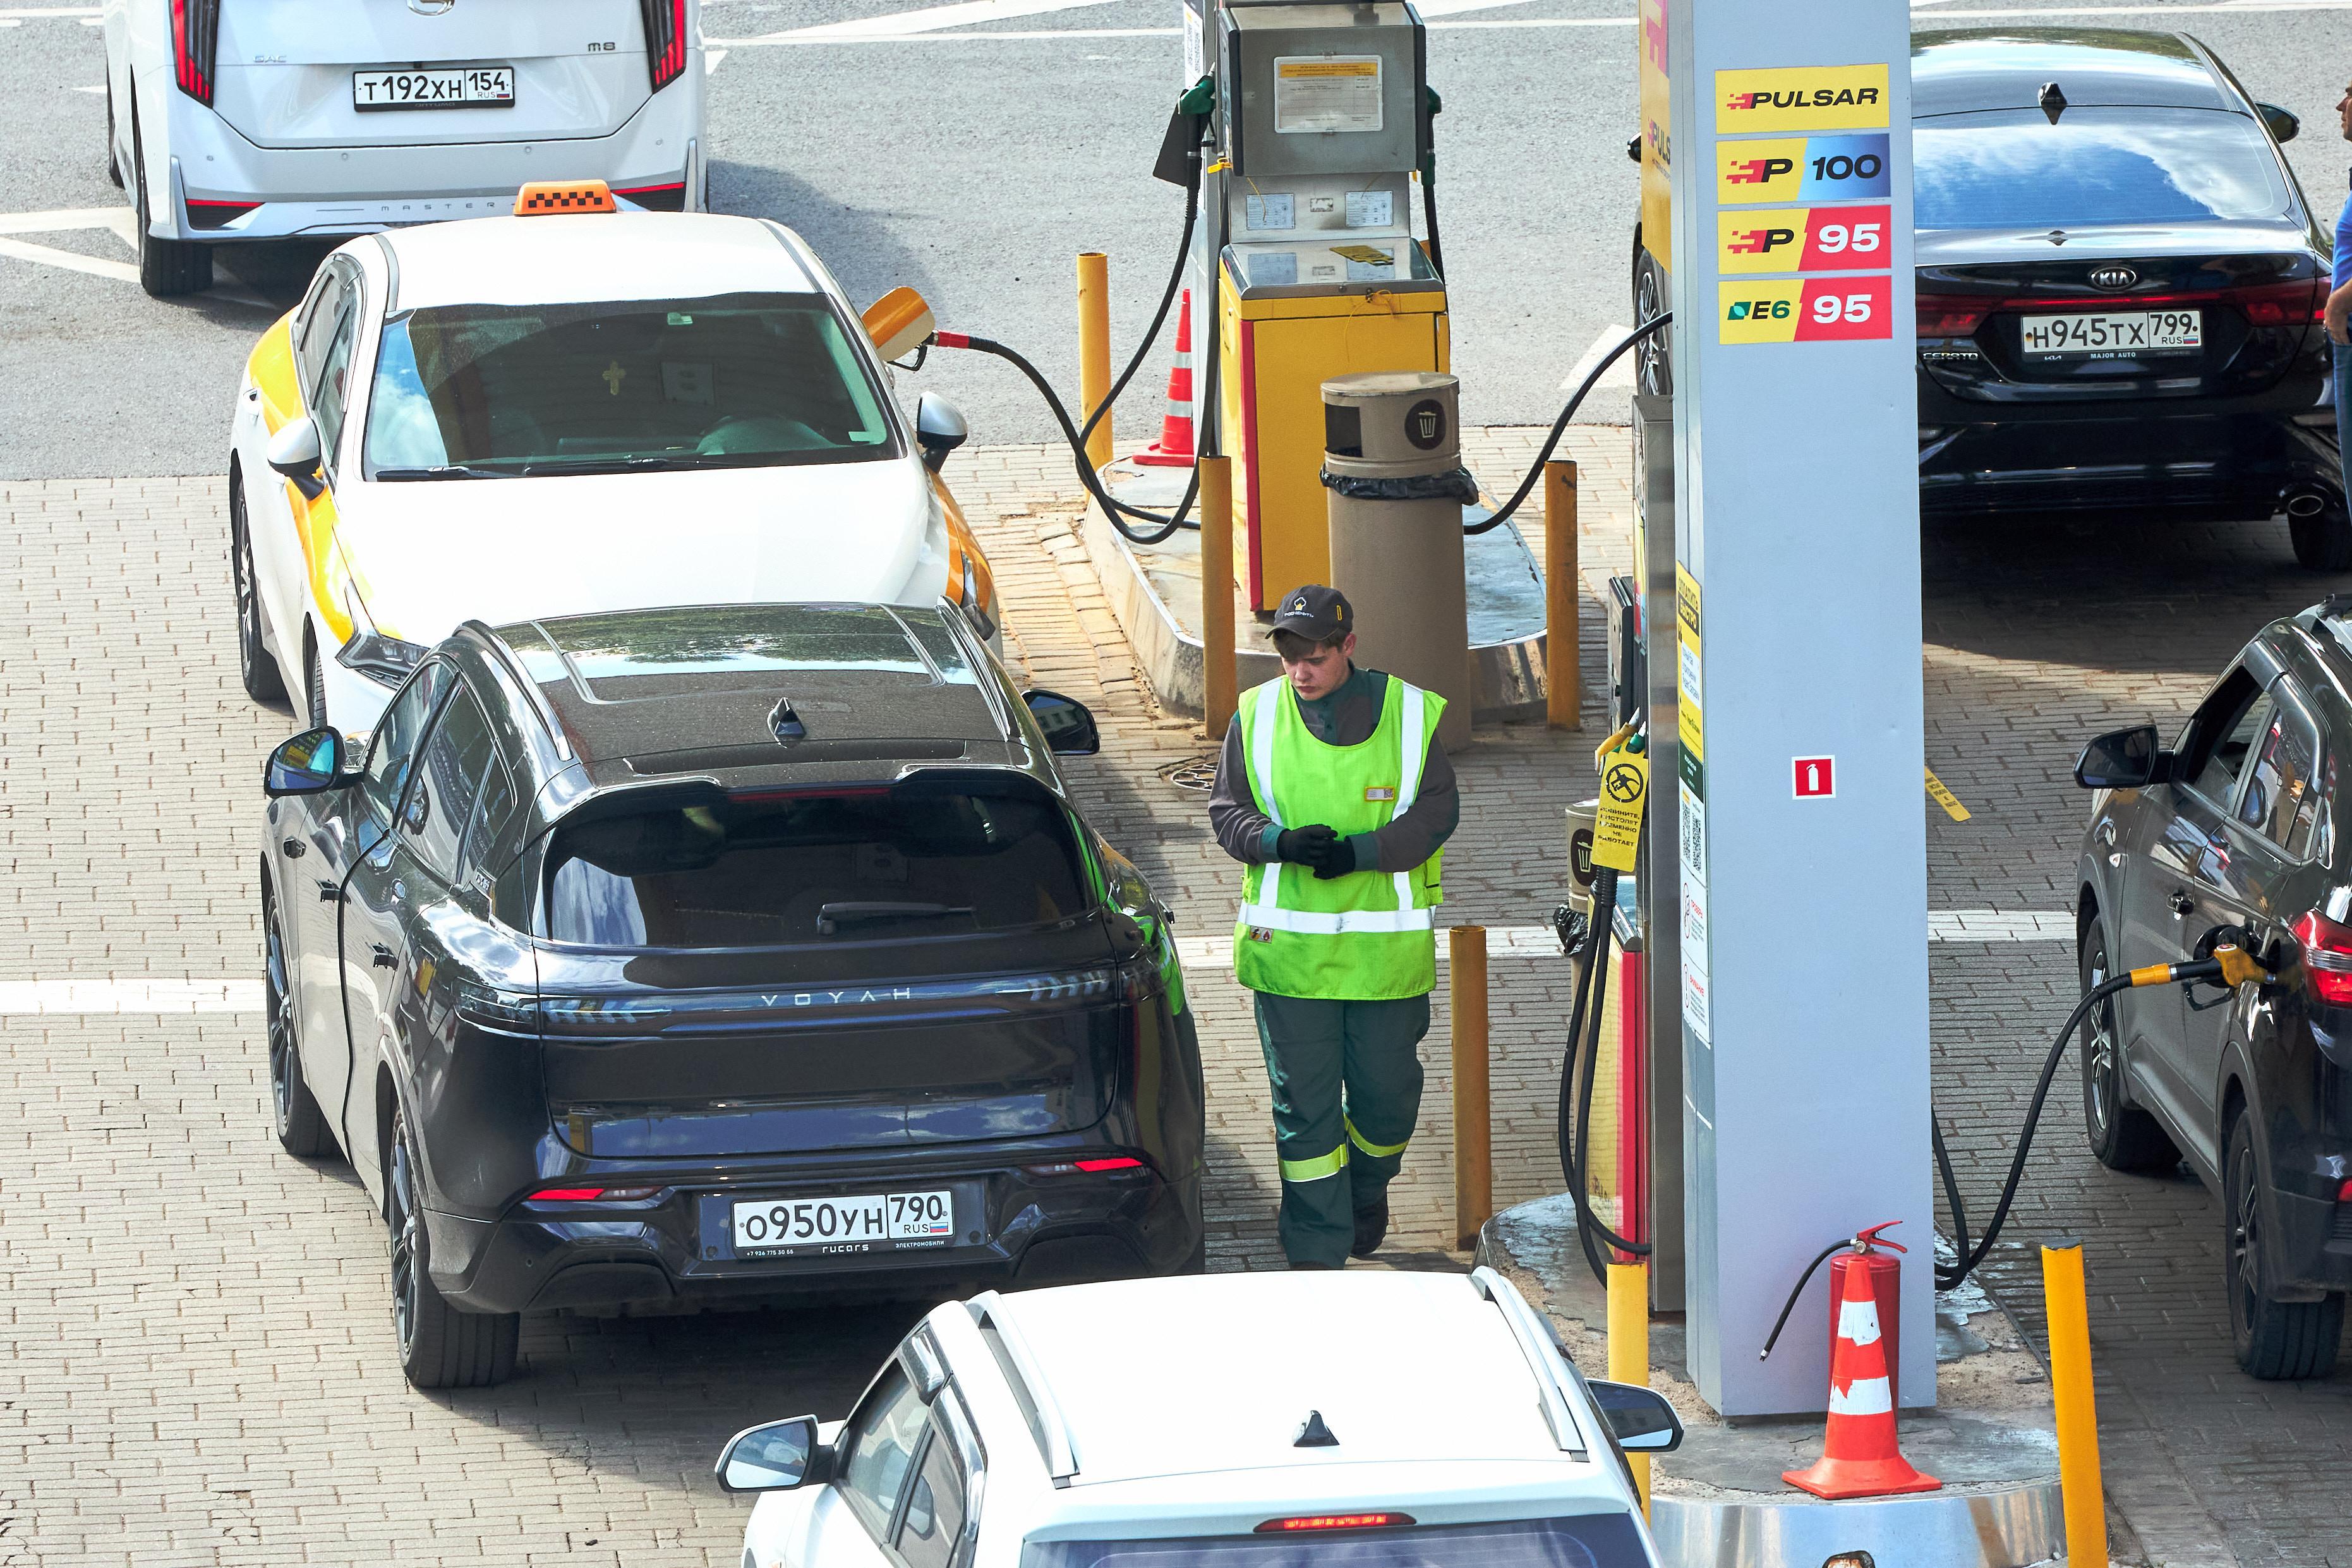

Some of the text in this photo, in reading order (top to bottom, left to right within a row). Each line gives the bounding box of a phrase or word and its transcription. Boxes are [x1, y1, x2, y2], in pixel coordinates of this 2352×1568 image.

[588, 42, 615, 52] M8
[253, 55, 287, 63] GAC
[364, 71, 505, 101] Т192ХН 154
[1751, 88, 1879, 109] PULSAR
[1761, 154, 1882, 183] P 100
[381, 202, 495, 212] MASTER
[1762, 223, 1881, 253] P 95
[2099, 271, 2128, 286] KIA
[1751, 294, 1873, 324] E6 95
[2032, 313, 2193, 349] Н945ТХ 799
[2161, 336, 2182, 345] RUS
[1598, 835, 1635, 847] РАБОТАЕТ
[761, 987, 910, 1007] VOYAH
[745, 1195, 943, 1241] О950УН 790
[903, 1224, 929, 1234] RUS
[822, 1244, 869, 1253] rucars
[895, 1240, 944, 1248] ЭЛЕКТРОМОБИЛИ
